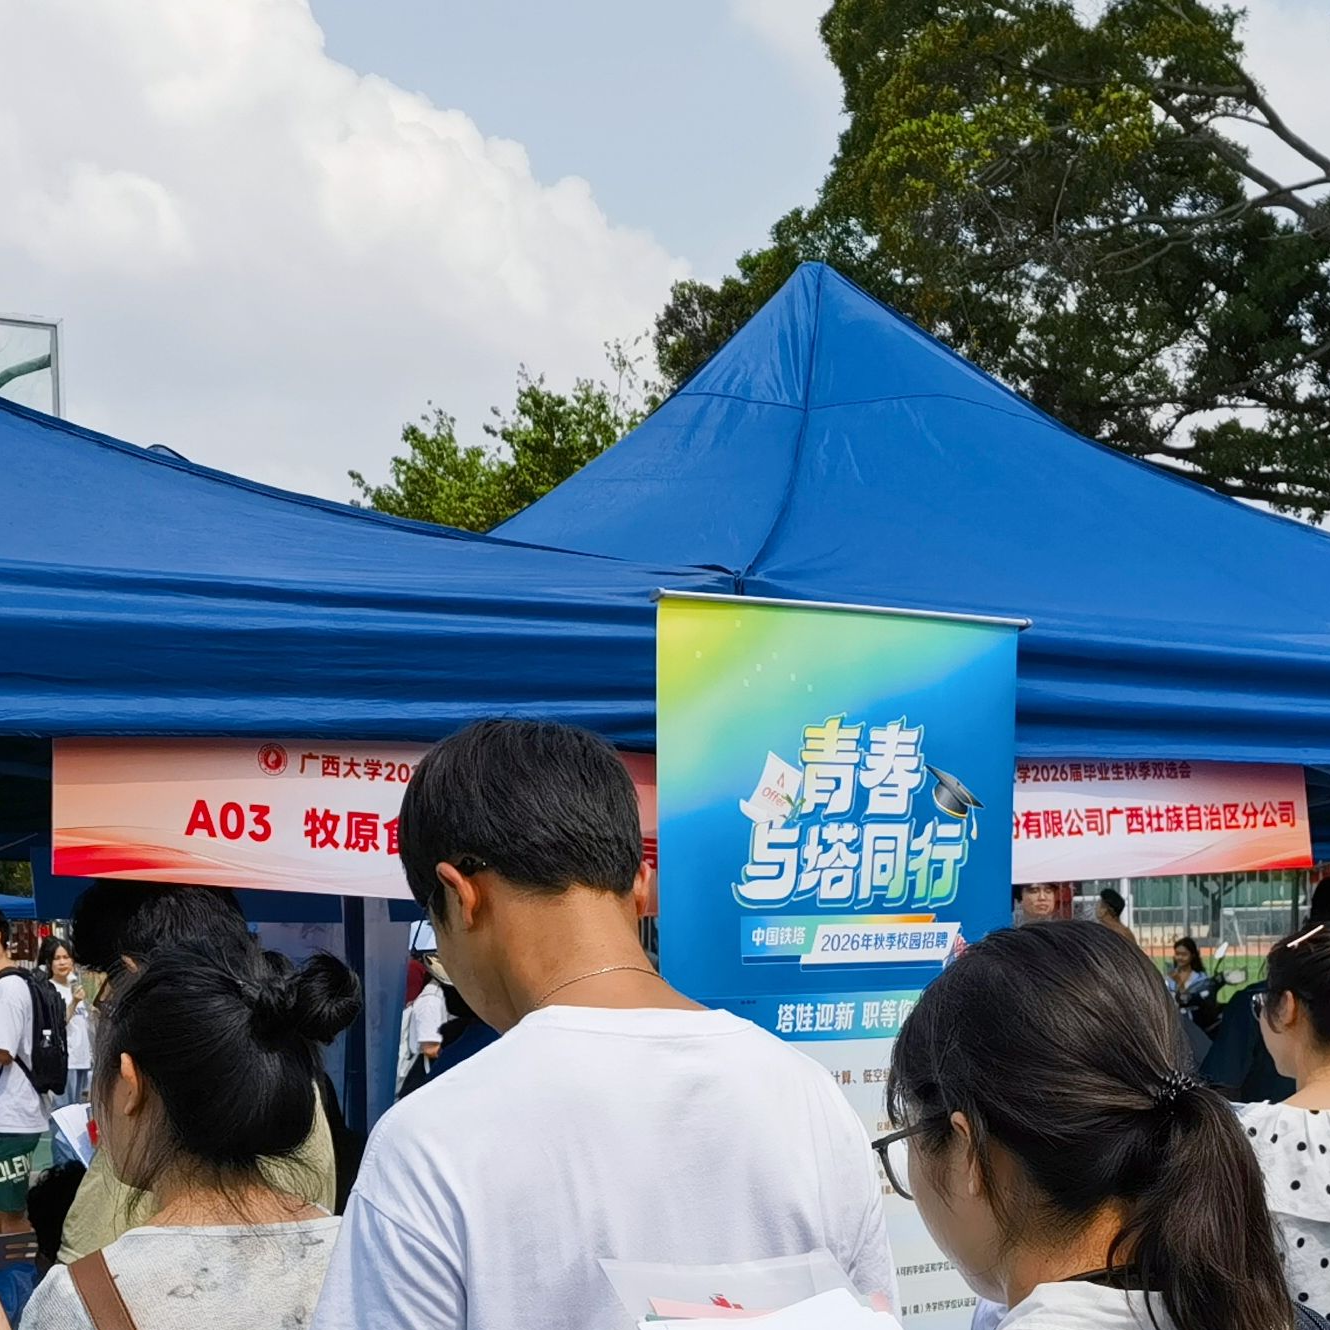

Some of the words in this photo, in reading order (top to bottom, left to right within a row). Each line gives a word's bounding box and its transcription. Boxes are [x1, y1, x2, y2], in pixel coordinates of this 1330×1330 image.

[800, 713, 924, 818] 青春
[1013, 760, 1192, 784] 学2026届毕业生秋季双选会
[185, 799, 272, 842] A03
[736, 818, 967, 908] 与塔同行
[751, 926, 807, 947] 中国铁塔
[821, 931, 949, 952] 2026年秋季校园招聘
[776, 1002, 855, 1034] 塔娃迎新
